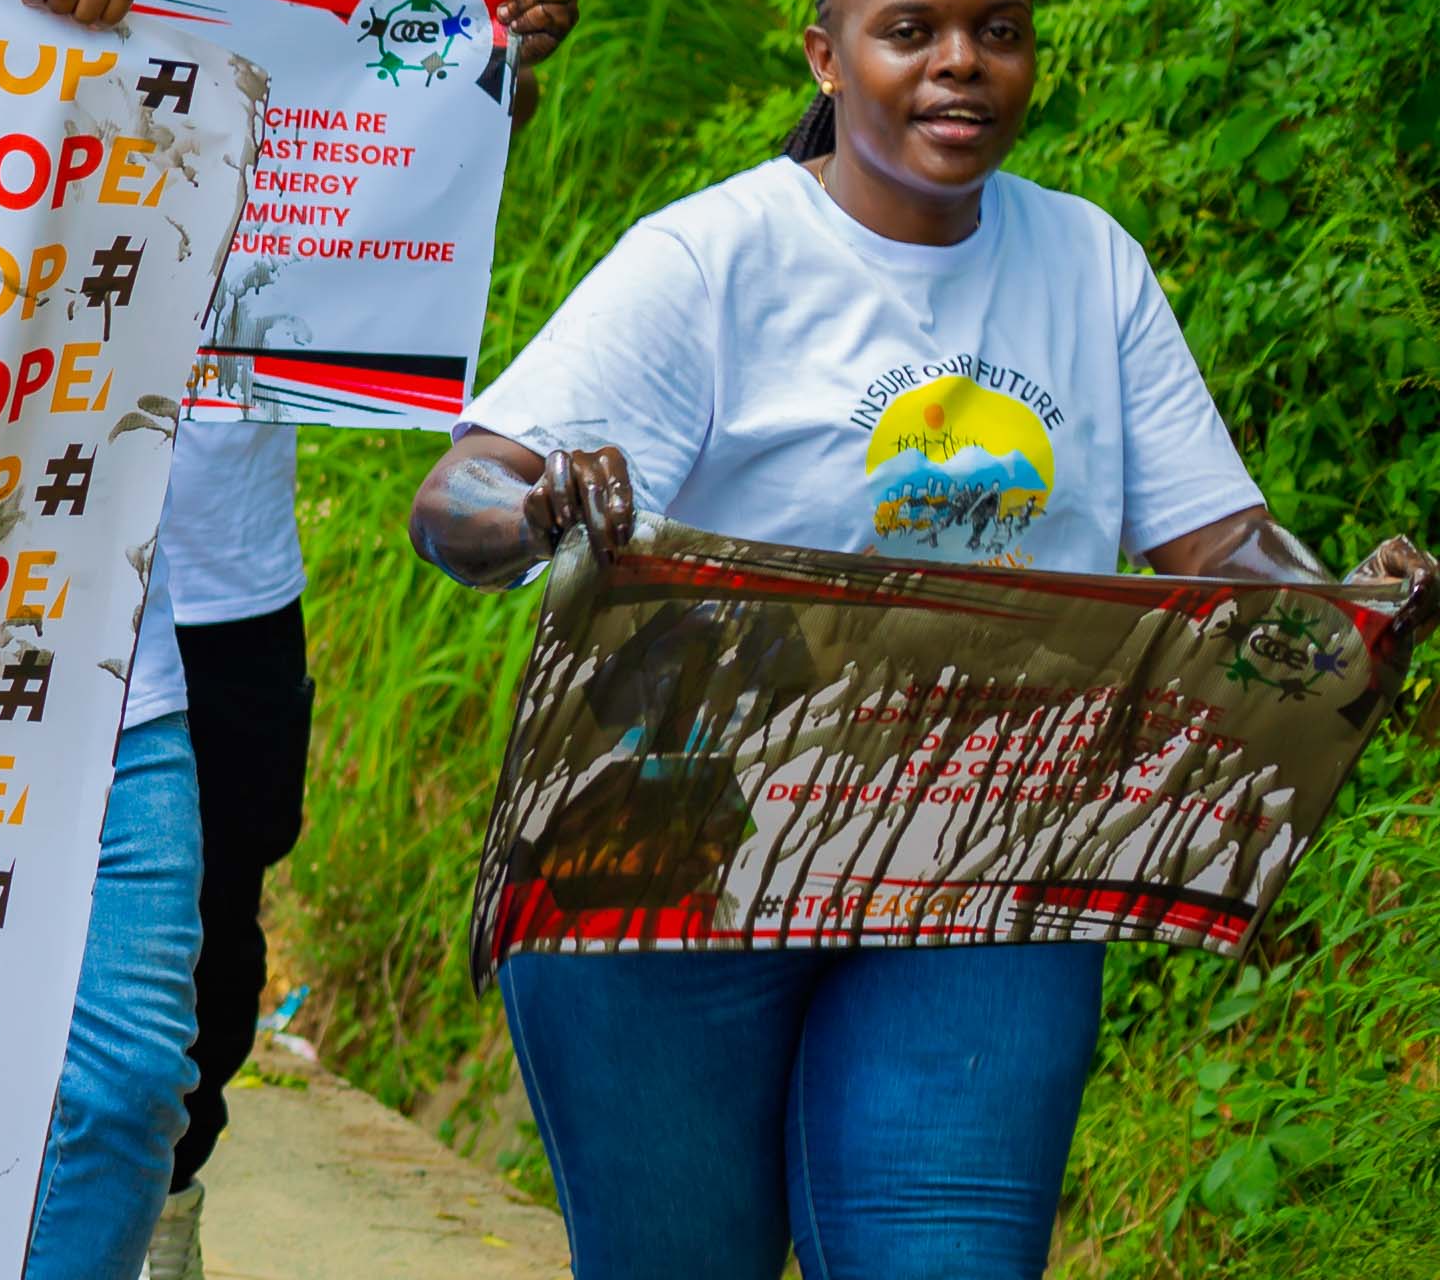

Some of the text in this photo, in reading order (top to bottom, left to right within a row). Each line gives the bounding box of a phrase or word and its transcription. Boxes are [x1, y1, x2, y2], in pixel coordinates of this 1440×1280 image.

[265, 107, 387, 134] CHINA RE
[312, 142, 416, 168] RESORT
[254, 170, 359, 196] ENERGY
[240, 201, 350, 228] MUNITY
[297, 237, 352, 260] OUR
[358, 240, 456, 264] FUTURE
[849, 352, 1065, 431] INSURE OUR FUTURE
